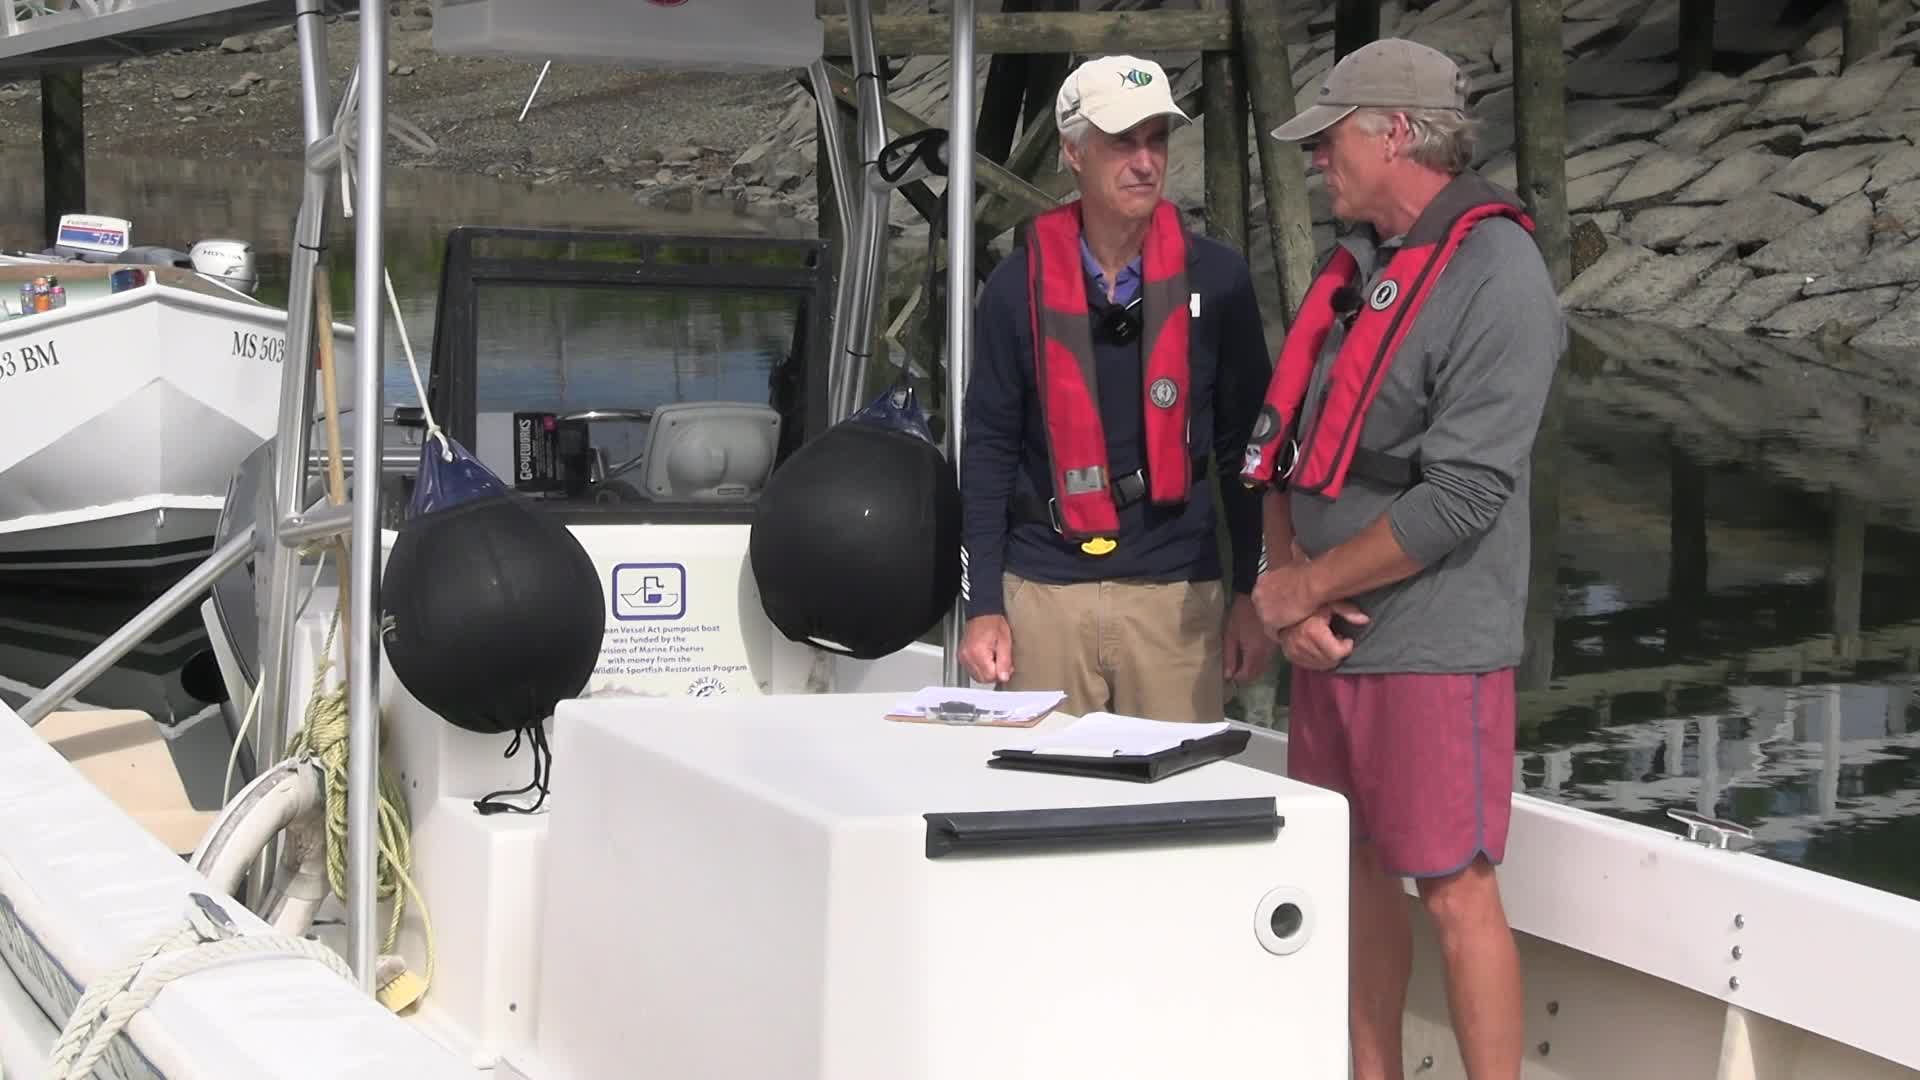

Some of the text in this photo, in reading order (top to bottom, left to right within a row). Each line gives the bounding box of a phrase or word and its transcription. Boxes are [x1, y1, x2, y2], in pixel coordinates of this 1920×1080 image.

[232, 331, 258, 359] MS
[19, 340, 60, 373] BM
[620, 626, 645, 634] Vessel
[662, 625, 699, 635] pumpout
[701, 624, 720, 632] boat
[661, 635, 671, 644] by
[627, 657, 656, 665] money
[656, 655, 676, 663] from
[626, 666, 662, 675] Sportfish
[664, 664, 711, 673] Restoration
[713, 664, 747, 674] Program
